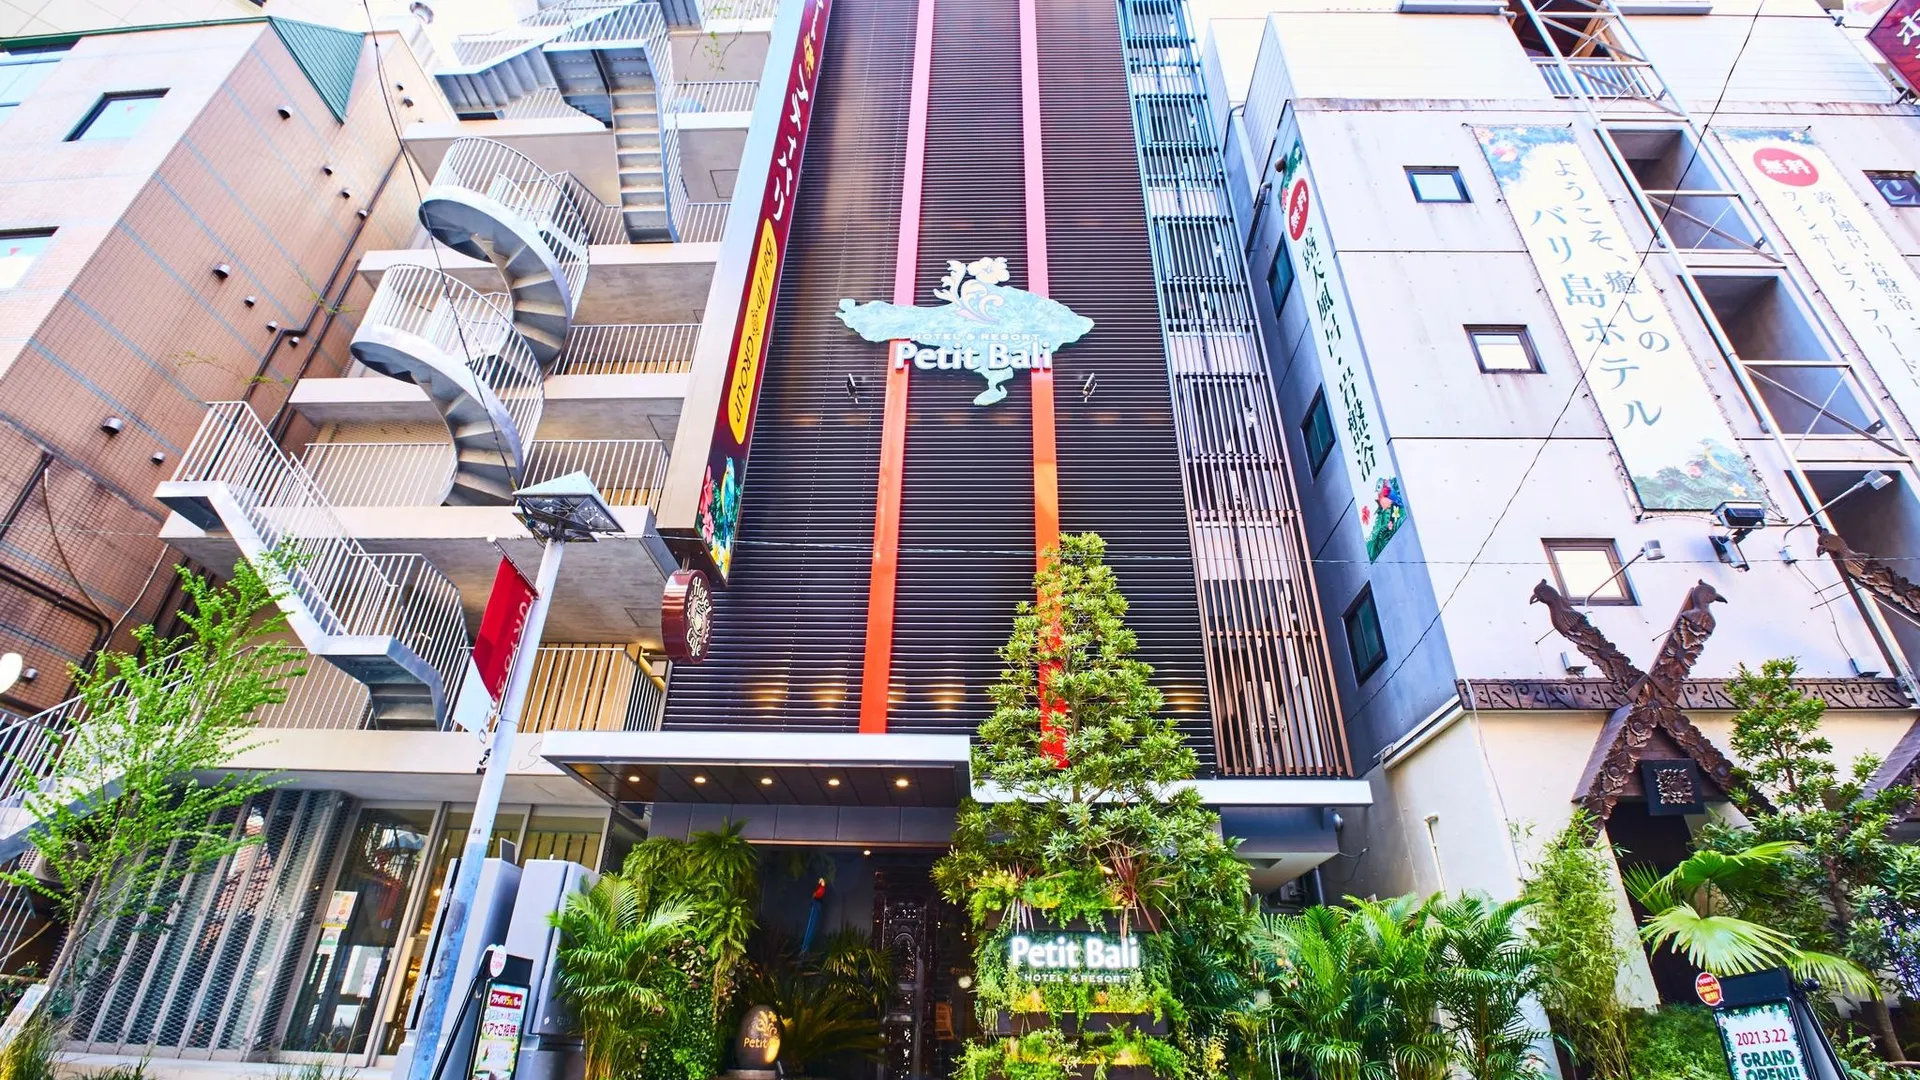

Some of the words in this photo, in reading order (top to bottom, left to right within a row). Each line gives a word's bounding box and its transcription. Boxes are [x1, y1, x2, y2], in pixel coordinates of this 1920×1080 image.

[1761, 155, 1812, 176] 無料
[1291, 186, 1307, 234] 無料
[1554, 159, 1670, 353] ようこそ、癒しの
[1813, 190, 1920, 336] 露天風呂・岩盤浴・
[1531, 205, 1663, 430] バリ島ホテル
[910, 333, 960, 341] HOTEL
[966, 333, 975, 341] &
[982, 333, 1040, 341] RESORT
[895, 341, 980, 370] Petit
[989, 341, 1052, 370] Bali
[1302, 226, 1377, 483] 露天風呂・岩盤浴
[736, 335, 755, 423] GROUP
[693, 577, 713, 616] Hotel
[1011, 936, 1080, 968] Petit
[1087, 936, 1139, 969] Bali
[1024, 974, 1064, 982] HOTEL
[1081, 975, 1129, 983] RESORT
[744, 1037, 768, 1048] Petit
[1735, 1028, 1788, 1046] 2021.3.22
[1741, 1050, 1795, 1068] GRAND
